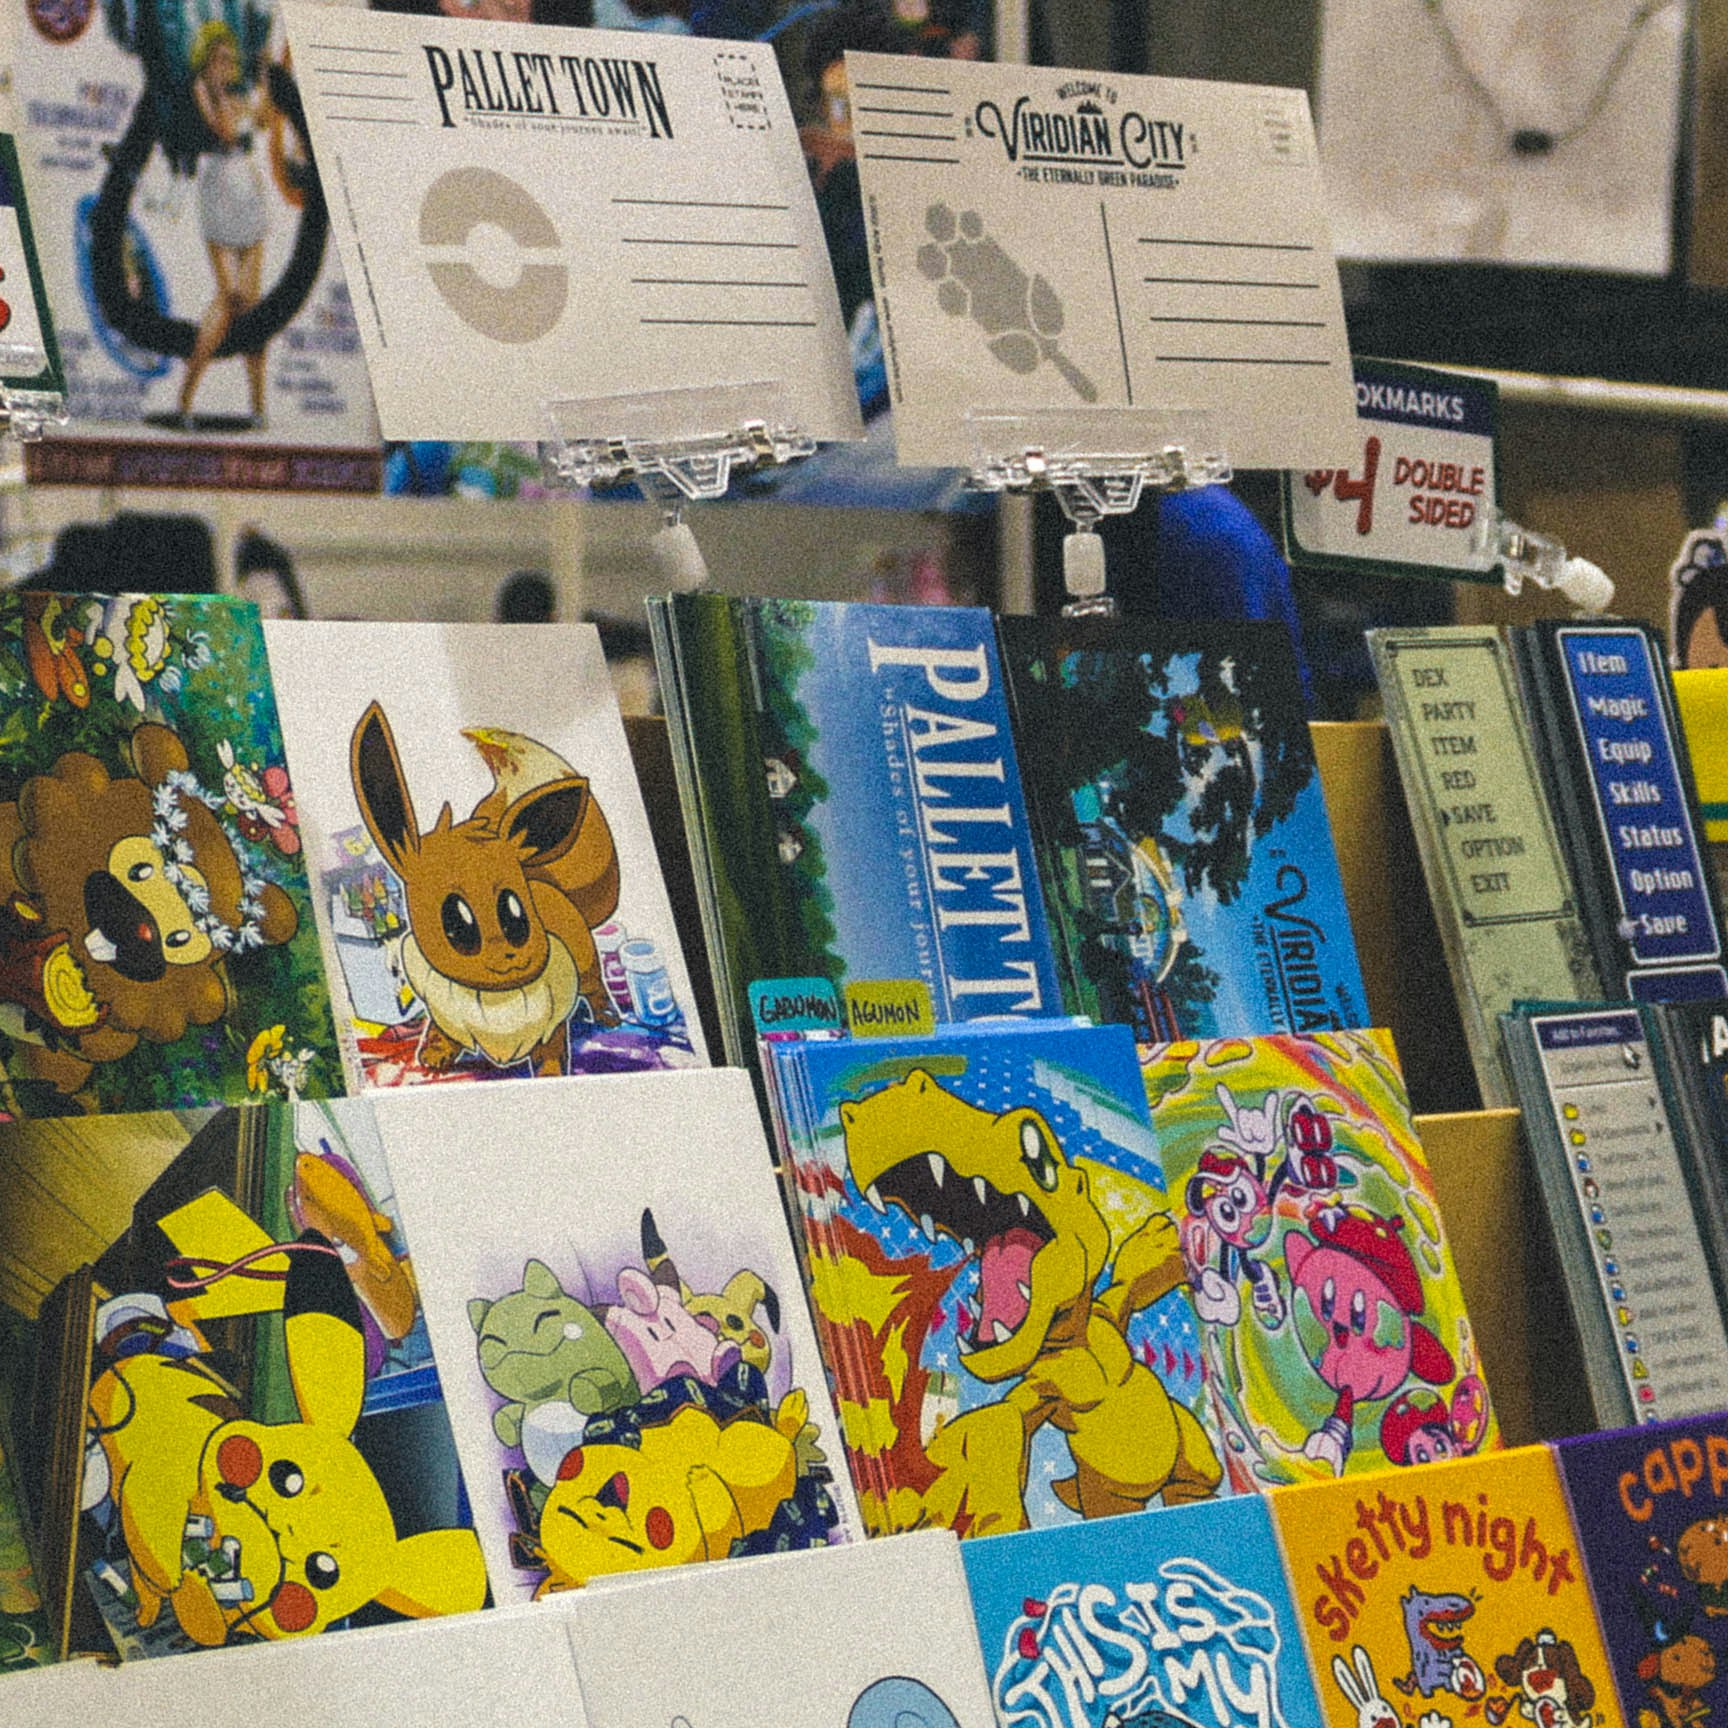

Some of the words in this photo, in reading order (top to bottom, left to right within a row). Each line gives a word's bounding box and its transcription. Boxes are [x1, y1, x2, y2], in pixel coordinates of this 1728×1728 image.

[422, 44, 560, 128] PALLET
[559, 54, 674, 139] TOWN
[975, 95, 1113, 162] VIRIDIAN
[1120, 111, 1185, 169] CITY
[1355, 381, 1466, 421] OKMARKS
[1392, 456, 1486, 496] DOUBLE
[1408, 494, 1476, 530] SIDED
[1576, 651, 1628, 675] Item
[1411, 667, 1450, 688] DEX
[1422, 701, 1477, 722] PARTY
[1588, 696, 1649, 724] Magic
[1431, 736, 1478, 756] ITEM
[1597, 737, 1653, 766] Equip
[867, 636, 1032, 943] PALLET
[1440, 769, 1477, 791] RED
[1608, 780, 1663, 805] Skills
[896, 809, 914, 838] of
[1451, 803, 1498, 825] SAVE
[1460, 836, 1526, 860] OPTION
[1618, 824, 1684, 849] Status
[899, 849, 924, 910] your
[1470, 871, 1512, 894] EXIT
[1629, 868, 1695, 896] Option
[1639, 913, 1689, 937] Save
[1263, 863, 1330, 1032] VIRIDIA
[758, 992, 839, 1025] GABUMON
[851, 1001, 921, 1027] AGUMON
[1440, 1491, 1575, 1597] night
[1125, 1579, 1217, 1653] IS
